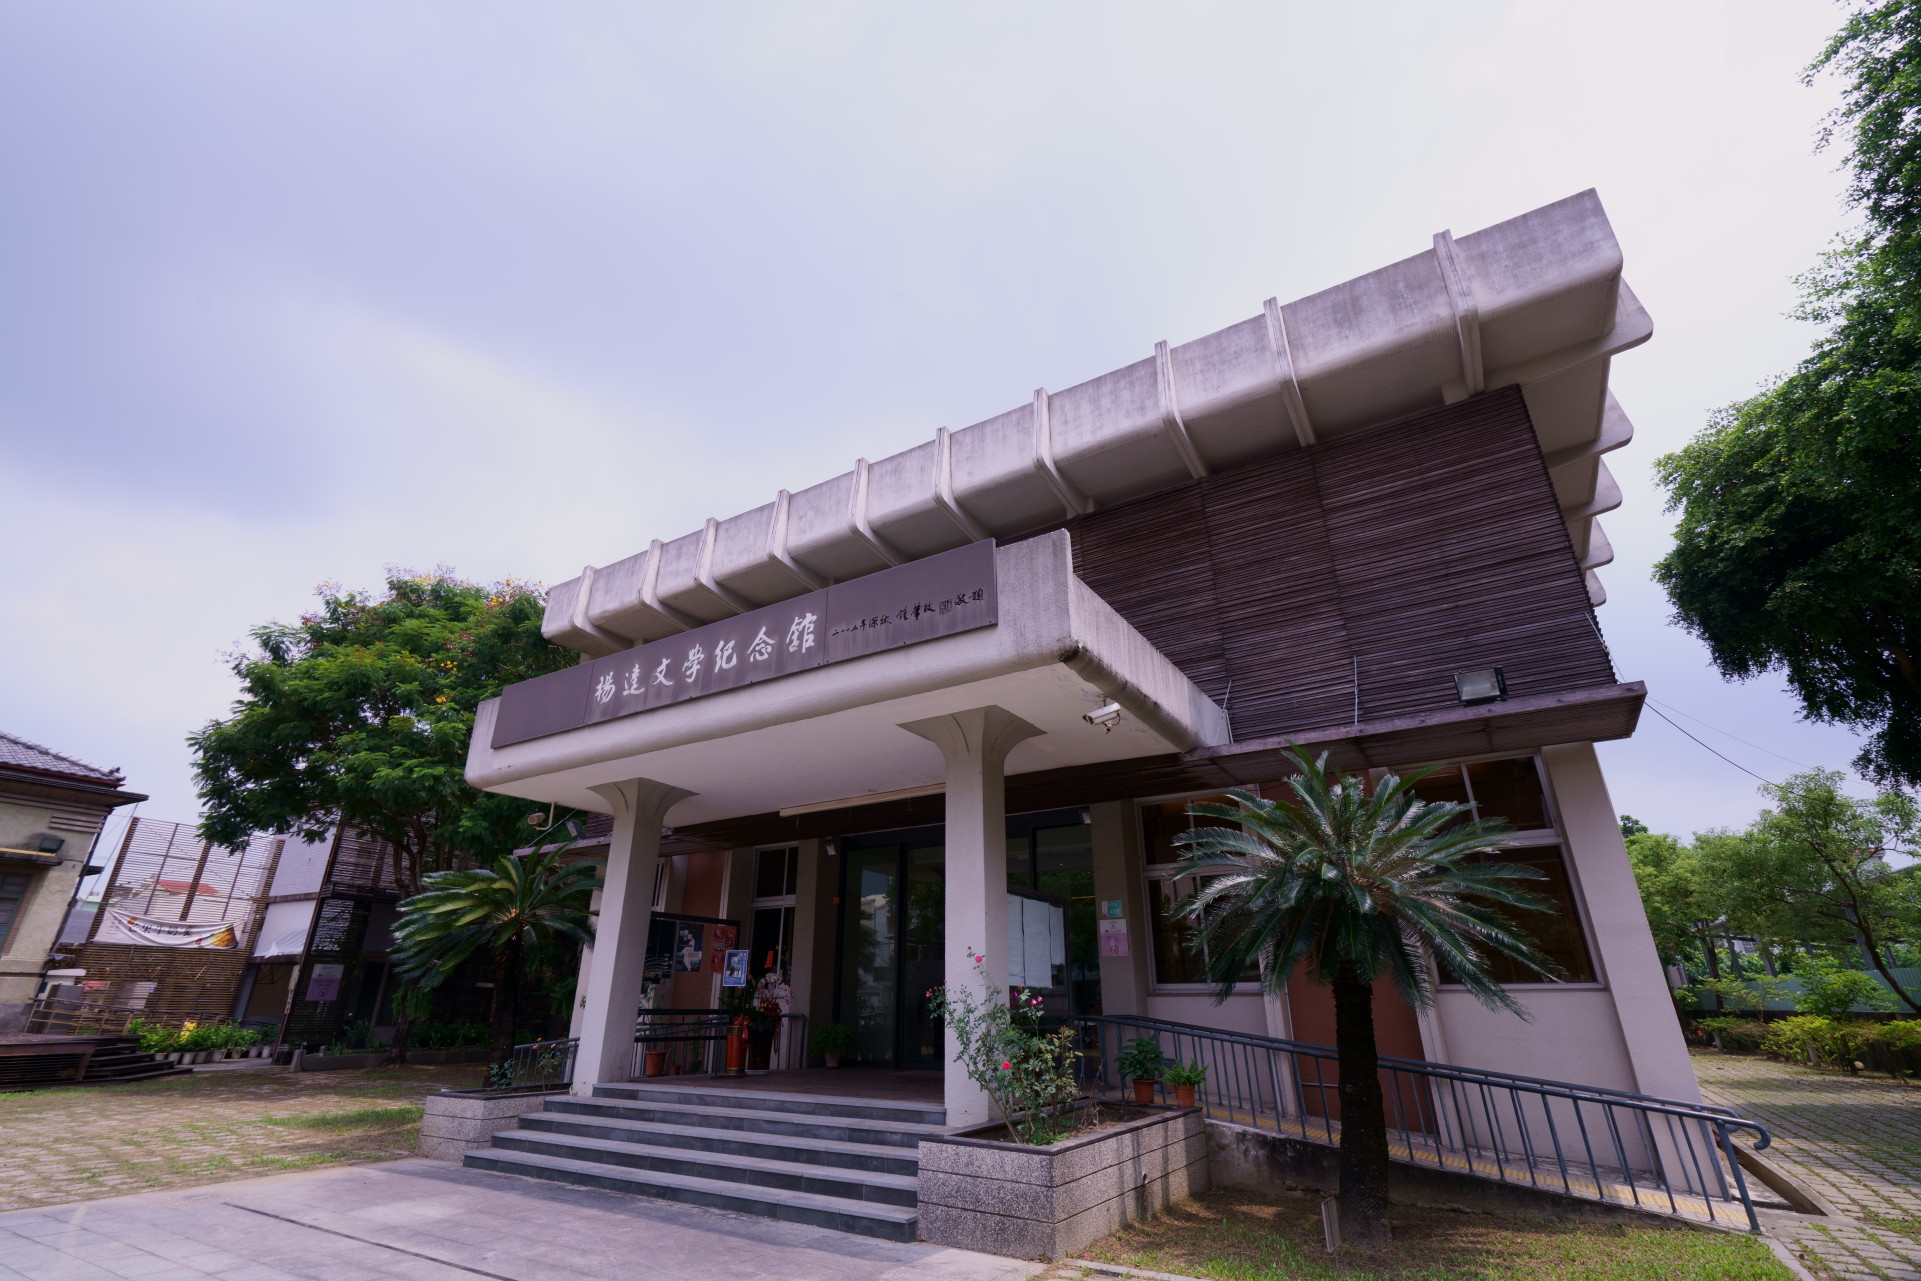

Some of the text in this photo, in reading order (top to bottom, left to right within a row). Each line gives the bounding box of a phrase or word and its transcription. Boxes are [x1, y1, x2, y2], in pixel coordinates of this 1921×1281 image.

[595, 612, 818, 704] 楊逵文學紀念館
